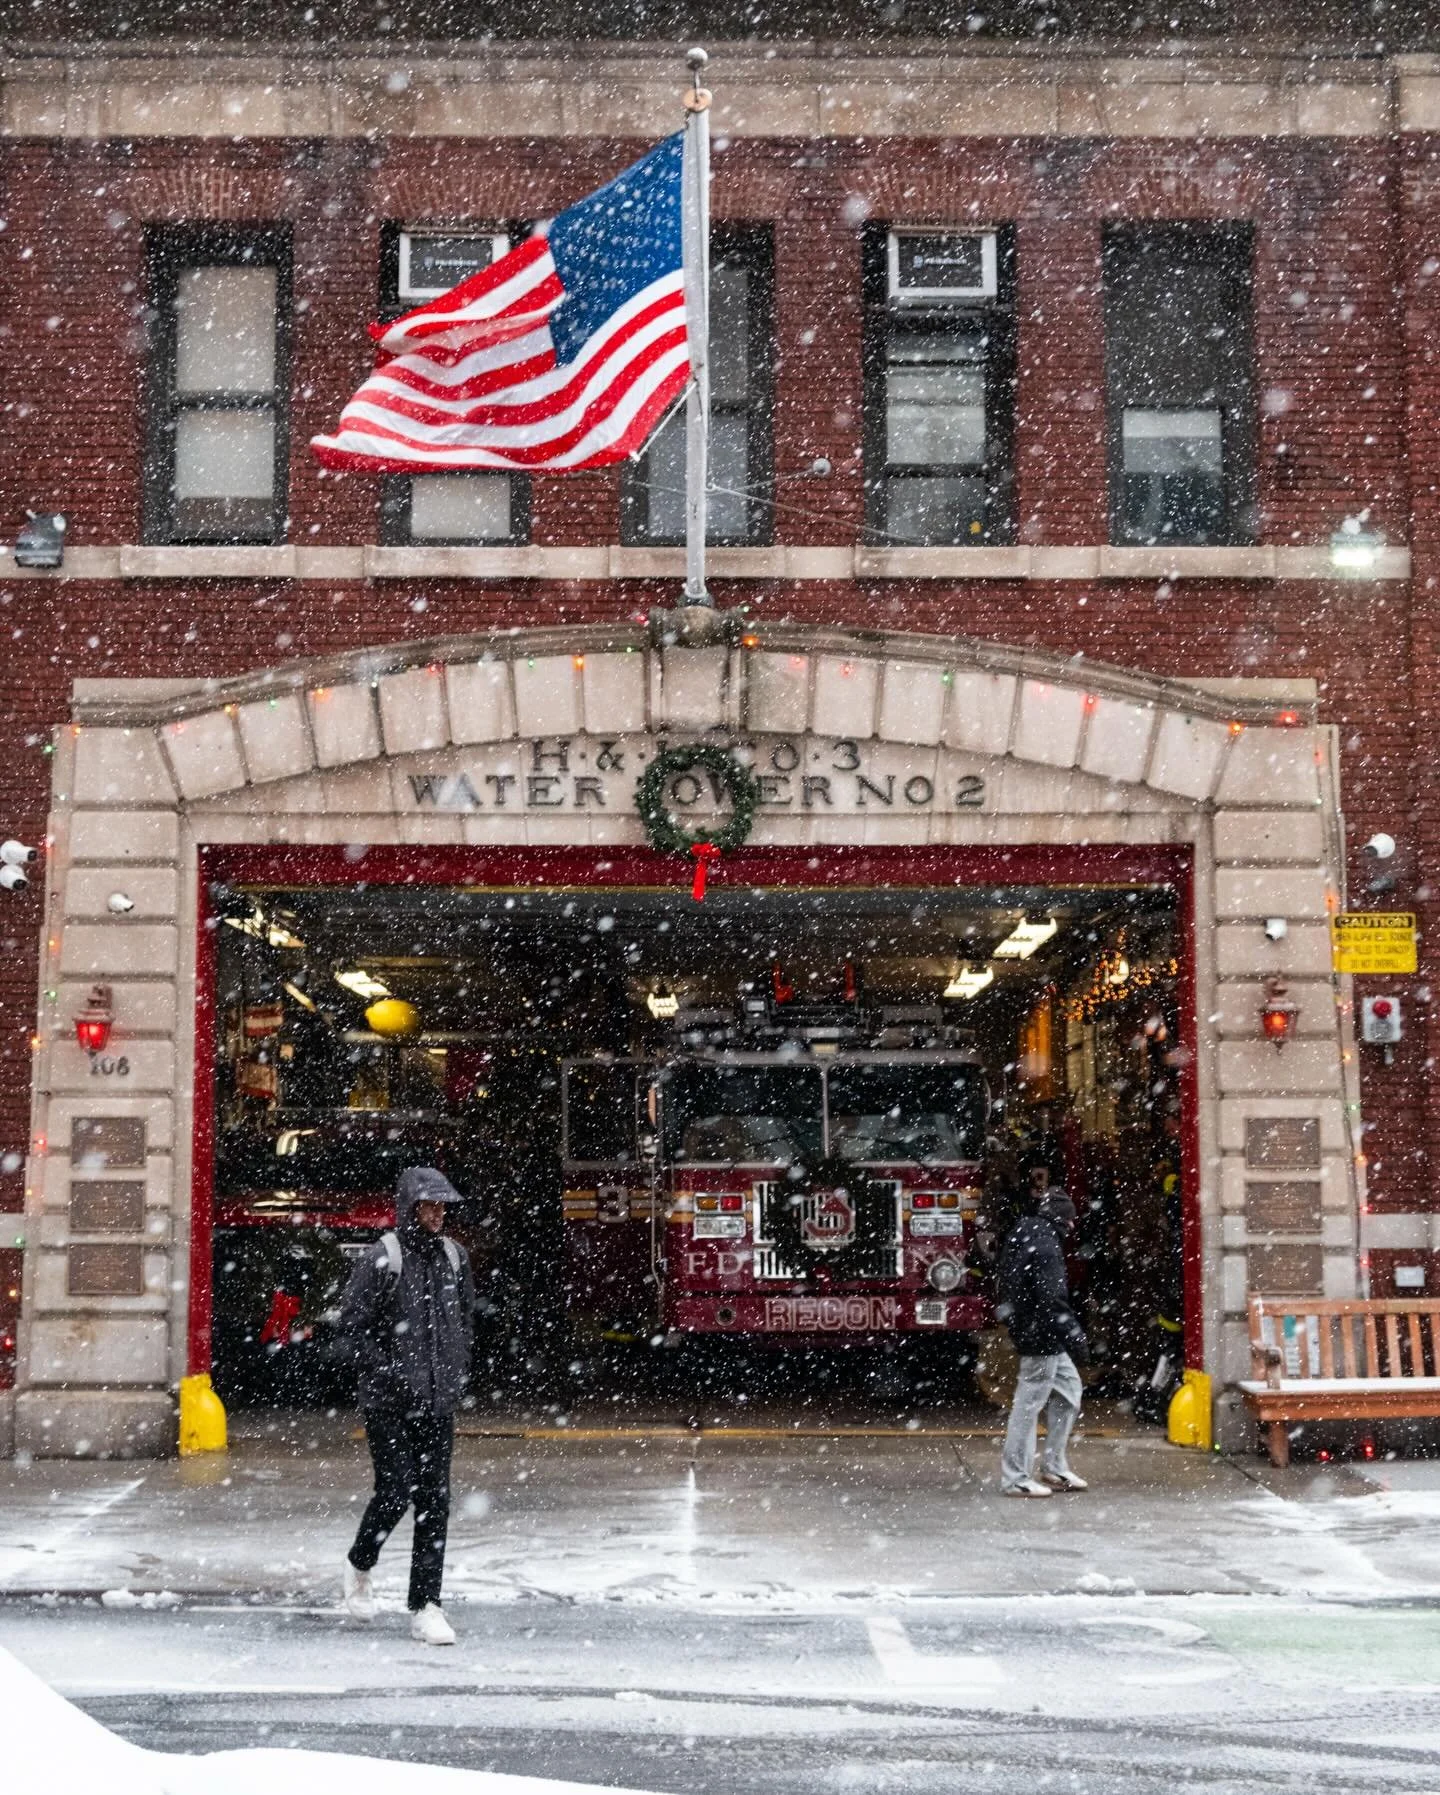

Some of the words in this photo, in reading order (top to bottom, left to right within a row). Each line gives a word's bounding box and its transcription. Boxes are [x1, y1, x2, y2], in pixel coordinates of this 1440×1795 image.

[408, 774, 606, 807] WATER
[637, 775, 833, 806] OWER
[856, 775, 933, 805] NO
[955, 775, 987, 806] 2
[1337, 916, 1409, 928] CAUTION
[598, 1185, 629, 1223] 3
[764, 1297, 896, 1331] RECON
